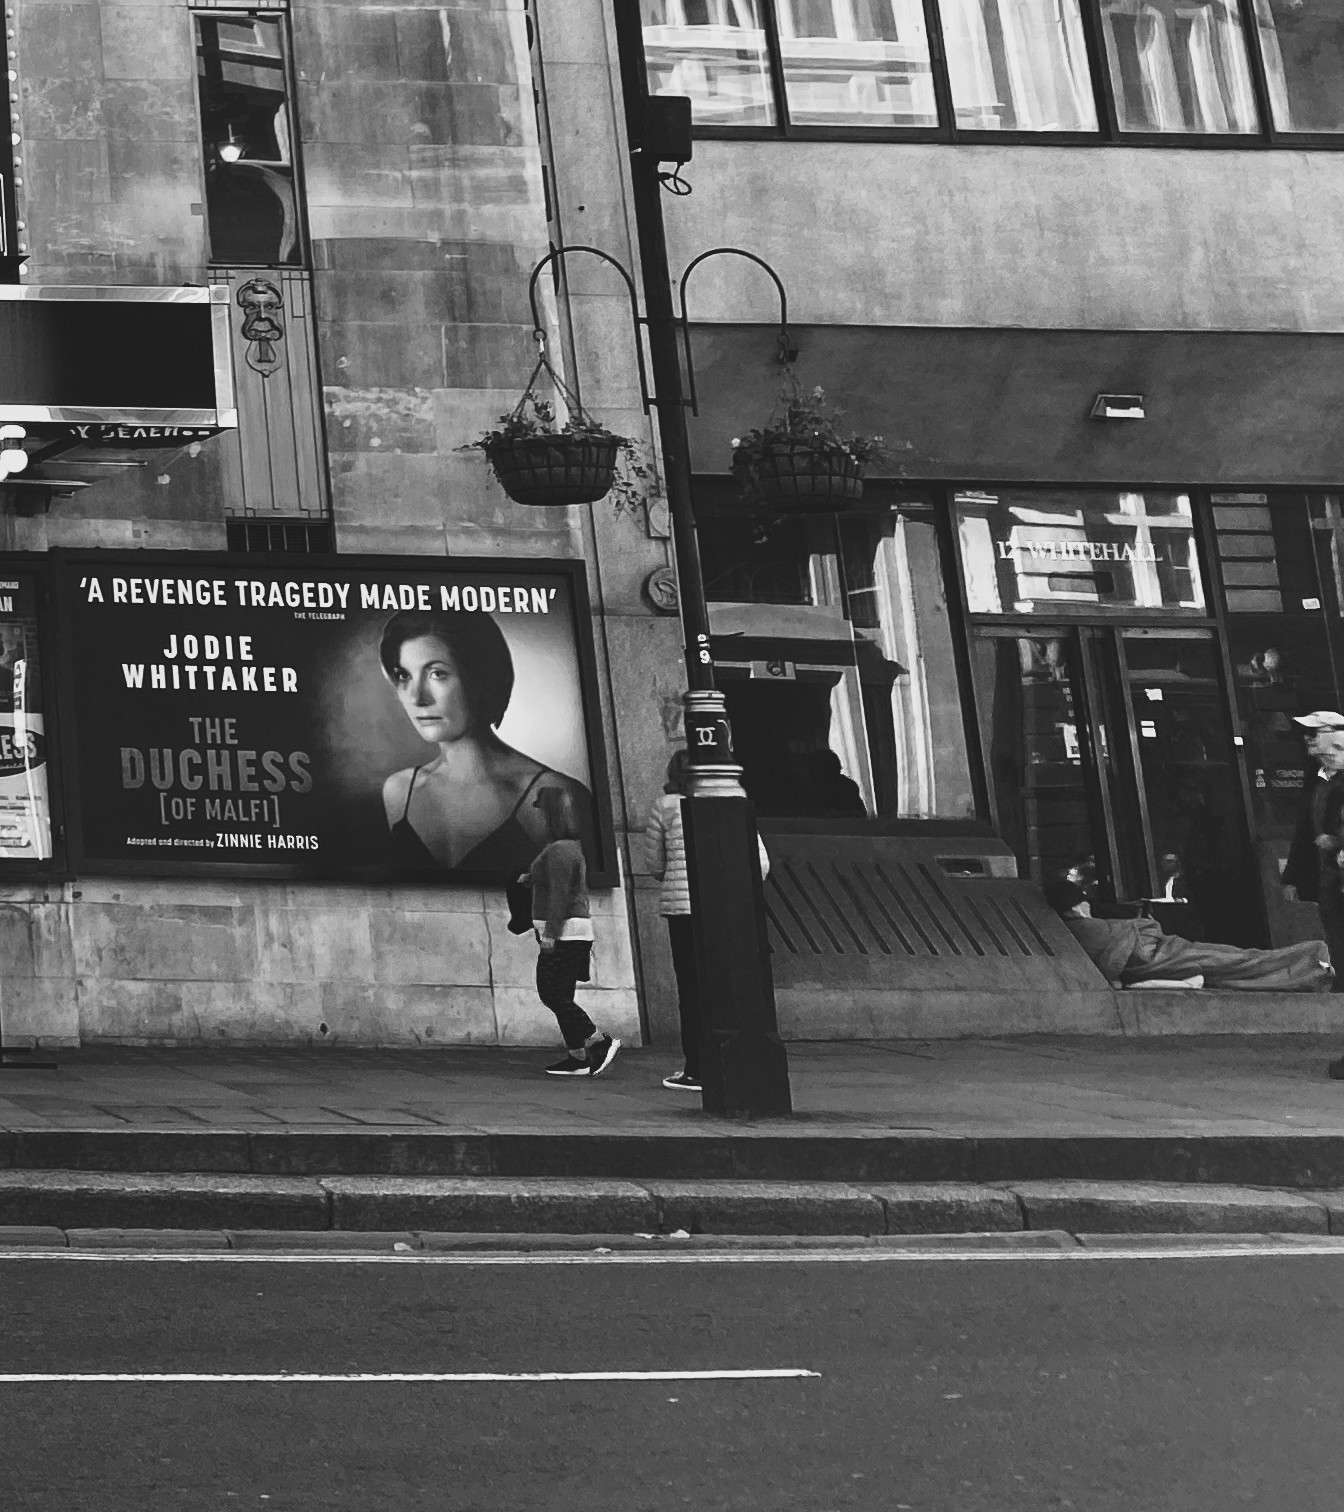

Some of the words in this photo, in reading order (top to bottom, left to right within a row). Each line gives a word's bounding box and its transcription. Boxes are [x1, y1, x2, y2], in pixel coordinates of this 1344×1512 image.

[1024, 541, 1163, 561] WHITEHALL
[112, 578, 227, 606] REVENGE
[234, 581, 350, 609] TRAGEDY
[361, 584, 432, 612] MADE
[441, 586, 557, 614] MODERN'
[163, 634, 253, 660] JODIE
[122, 664, 298, 693] WHITTAKER
[189, 717, 239, 745] THE
[120, 747, 312, 793] DUCHESS
[158, 837, 172, 846] and
[174, 838, 204, 847] directed
[205, 839, 215, 849] by
[216, 833, 263, 849] ZINNIE
[267, 834, 319, 850] HARRIS
